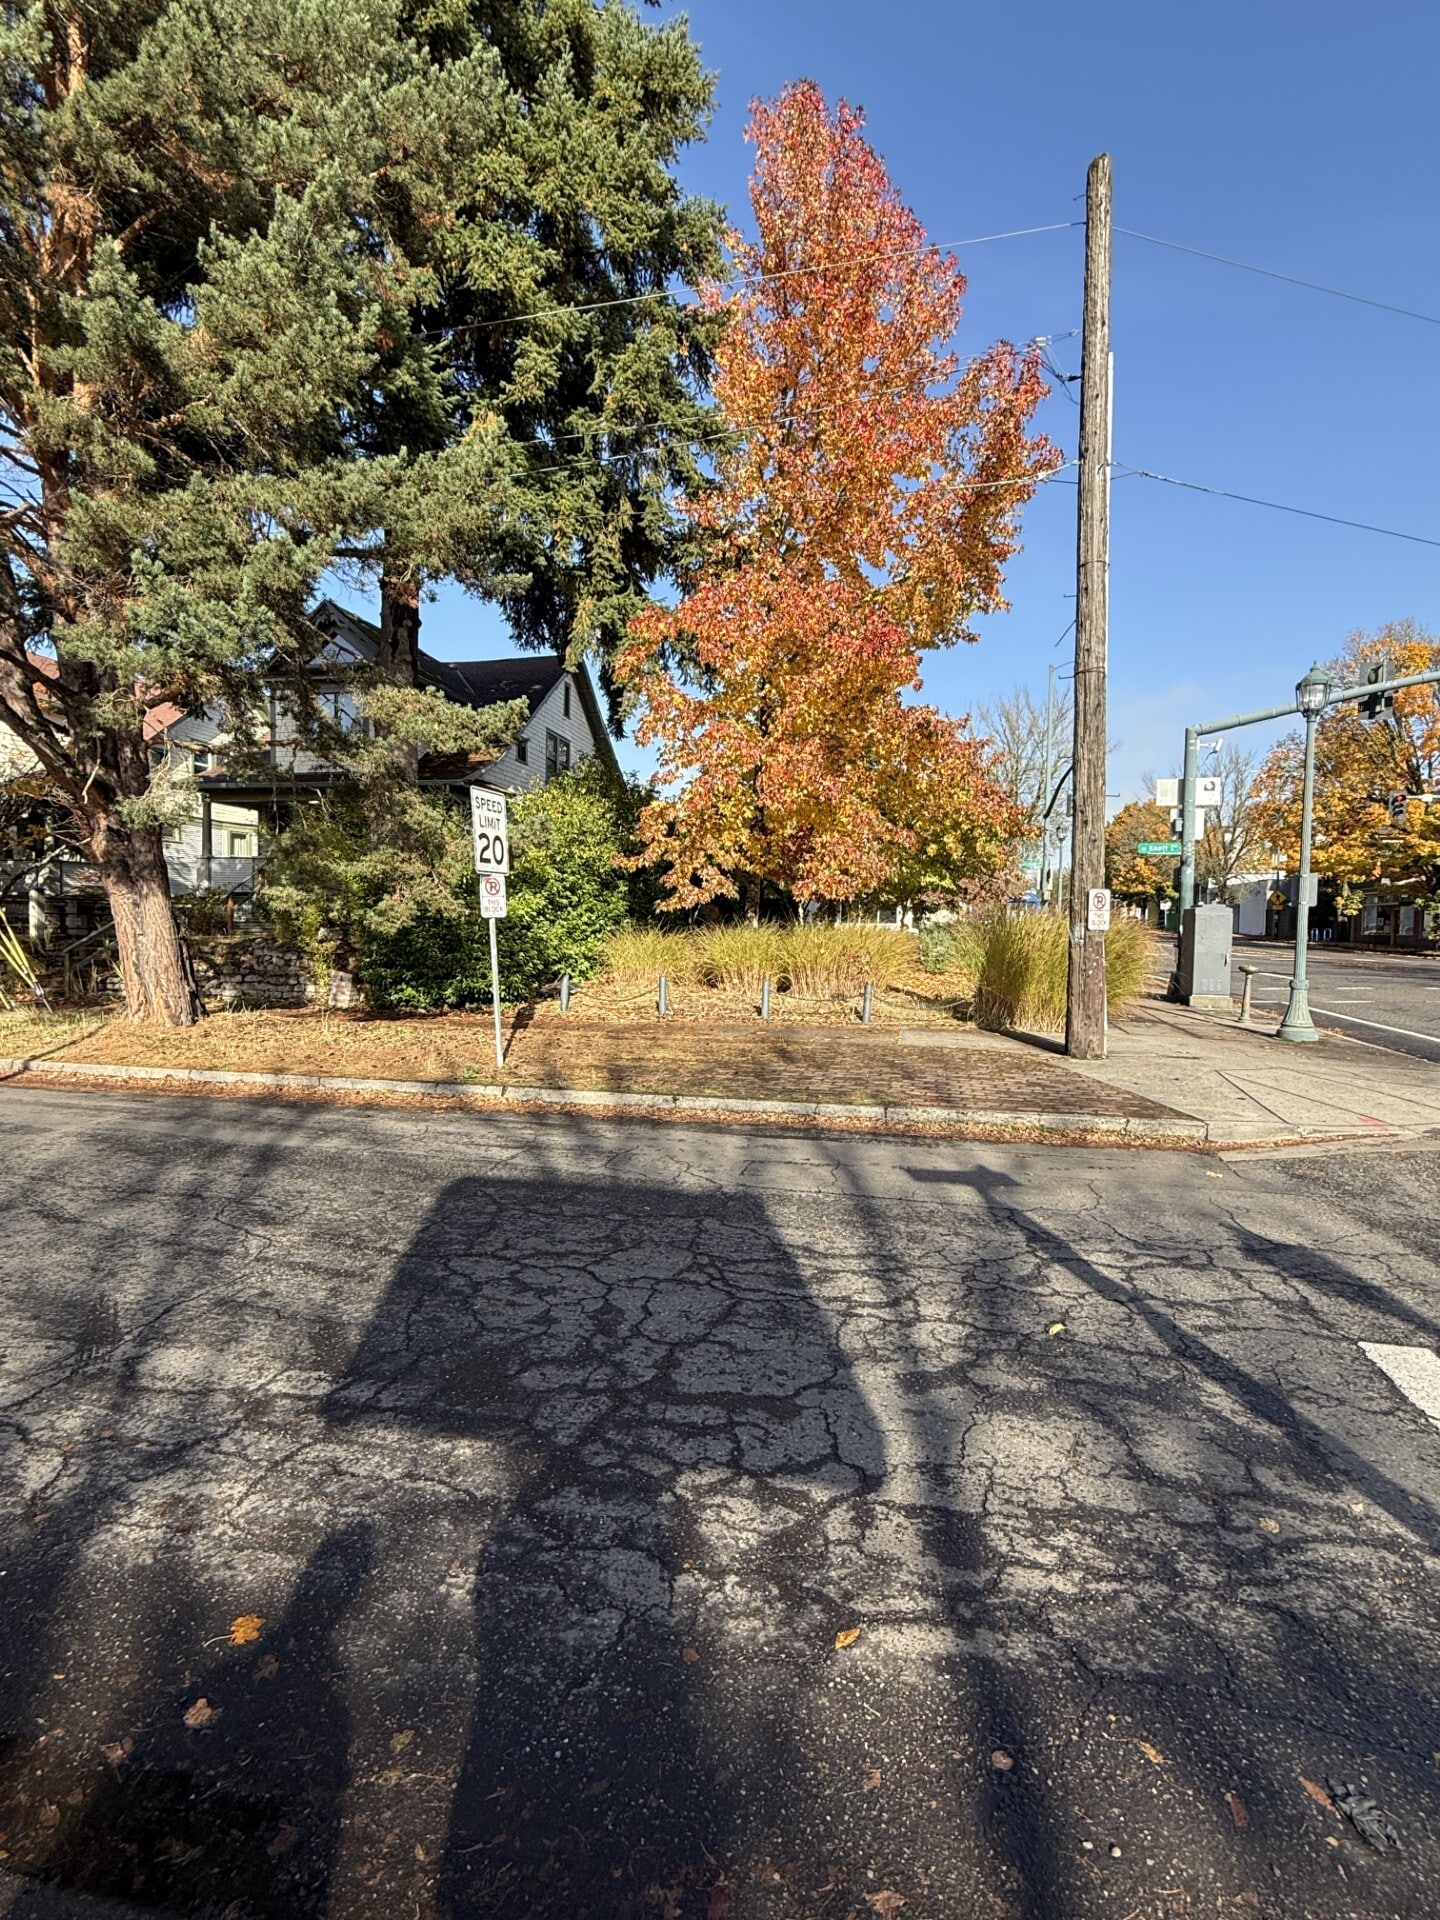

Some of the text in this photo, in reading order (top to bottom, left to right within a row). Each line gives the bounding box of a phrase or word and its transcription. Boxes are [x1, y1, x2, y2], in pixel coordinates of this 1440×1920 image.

[475, 797, 502, 814] SPEED
[479, 814, 501, 830] LIMIT
[478, 833, 504, 865] 20
